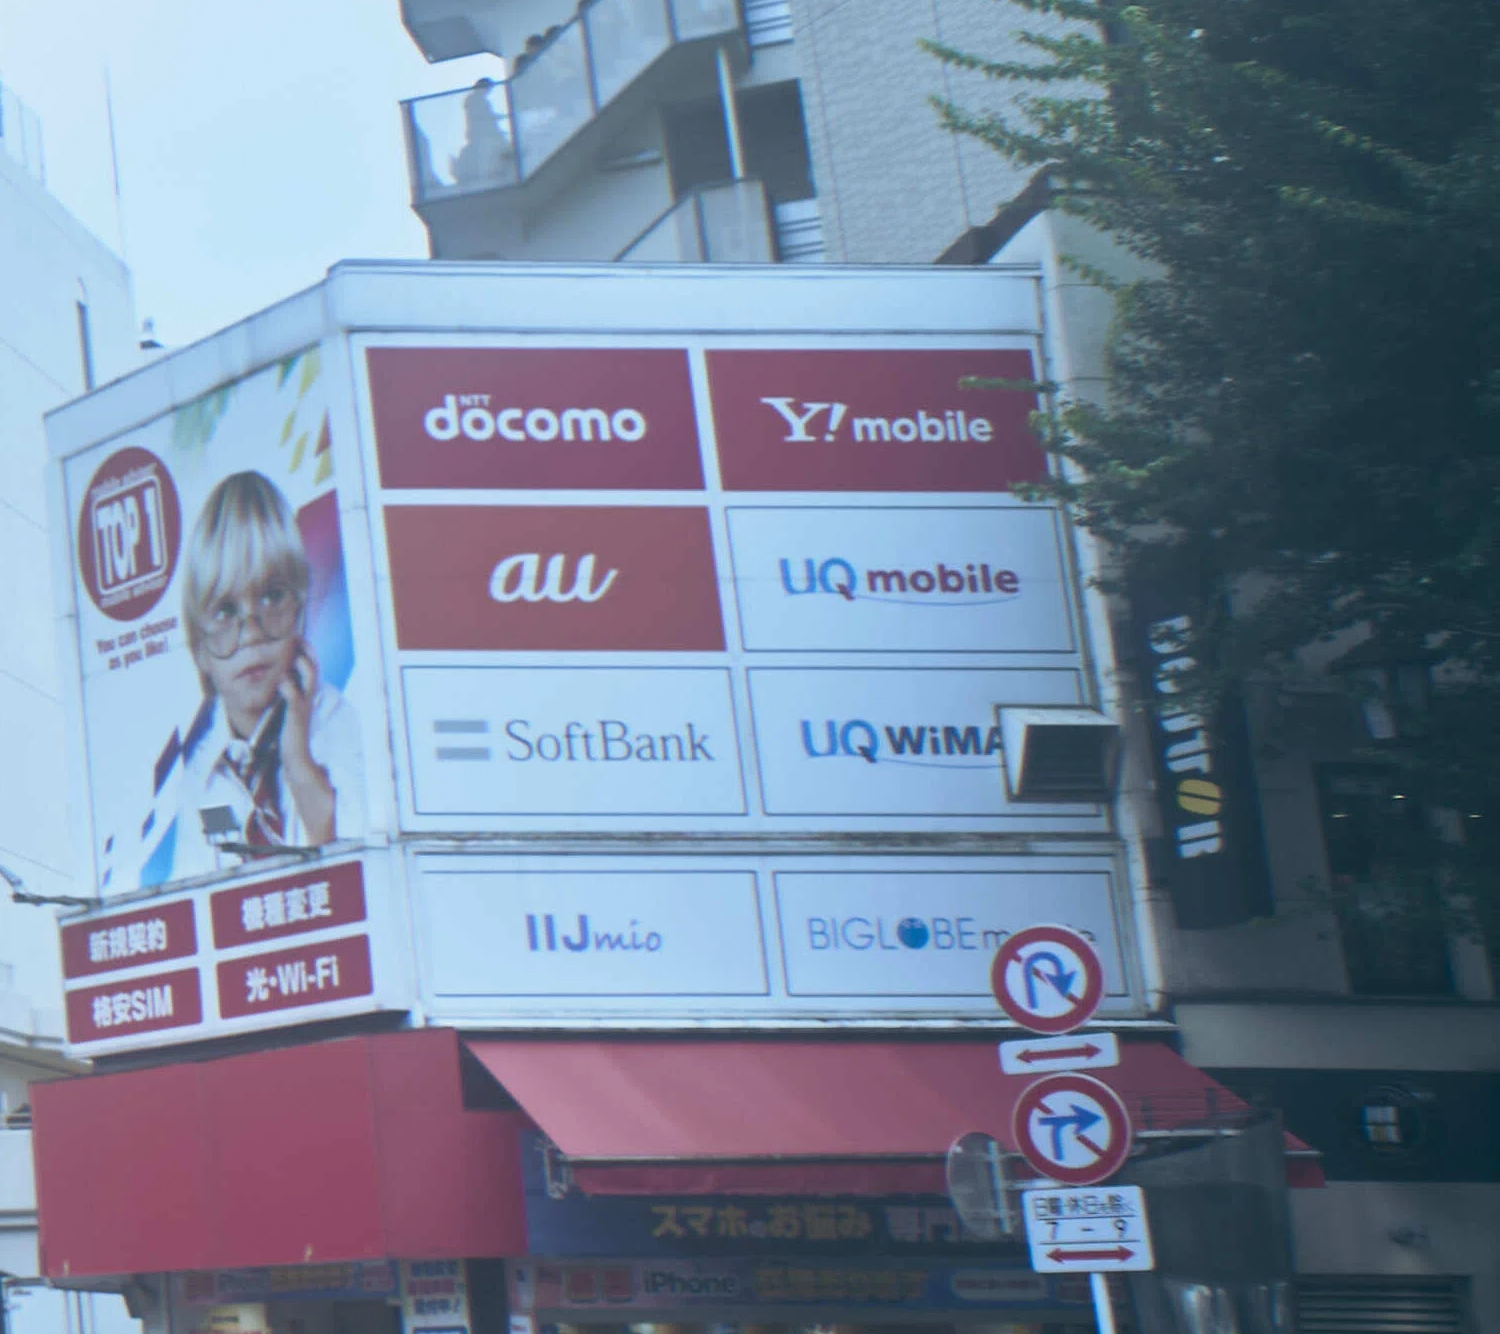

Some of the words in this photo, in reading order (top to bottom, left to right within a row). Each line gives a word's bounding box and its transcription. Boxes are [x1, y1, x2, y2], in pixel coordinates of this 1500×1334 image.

[424, 394, 646, 442] docomo
[96, 495, 141, 586] TOP
[143, 486, 161, 567] 1
[489, 552, 618, 603] au
[779, 557, 857, 601] UQ
[866, 563, 1020, 593] mobile
[96, 636, 115, 655] You
[118, 628, 138, 648] can
[139, 616, 178, 641] choose
[505, 719, 716, 762] SoftBank
[800, 719, 878, 763] UQ
[884, 725, 1004, 755] WiMA
[242, 882, 332, 932] 機種変更
[89, 919, 167, 963] 新規契約
[525, 914, 663, 952] IIJmio
[806, 917, 977, 951] BIGLOBE
[93, 985, 173, 1028] 格安SIM
[644, 1268, 736, 1296] iPhone
